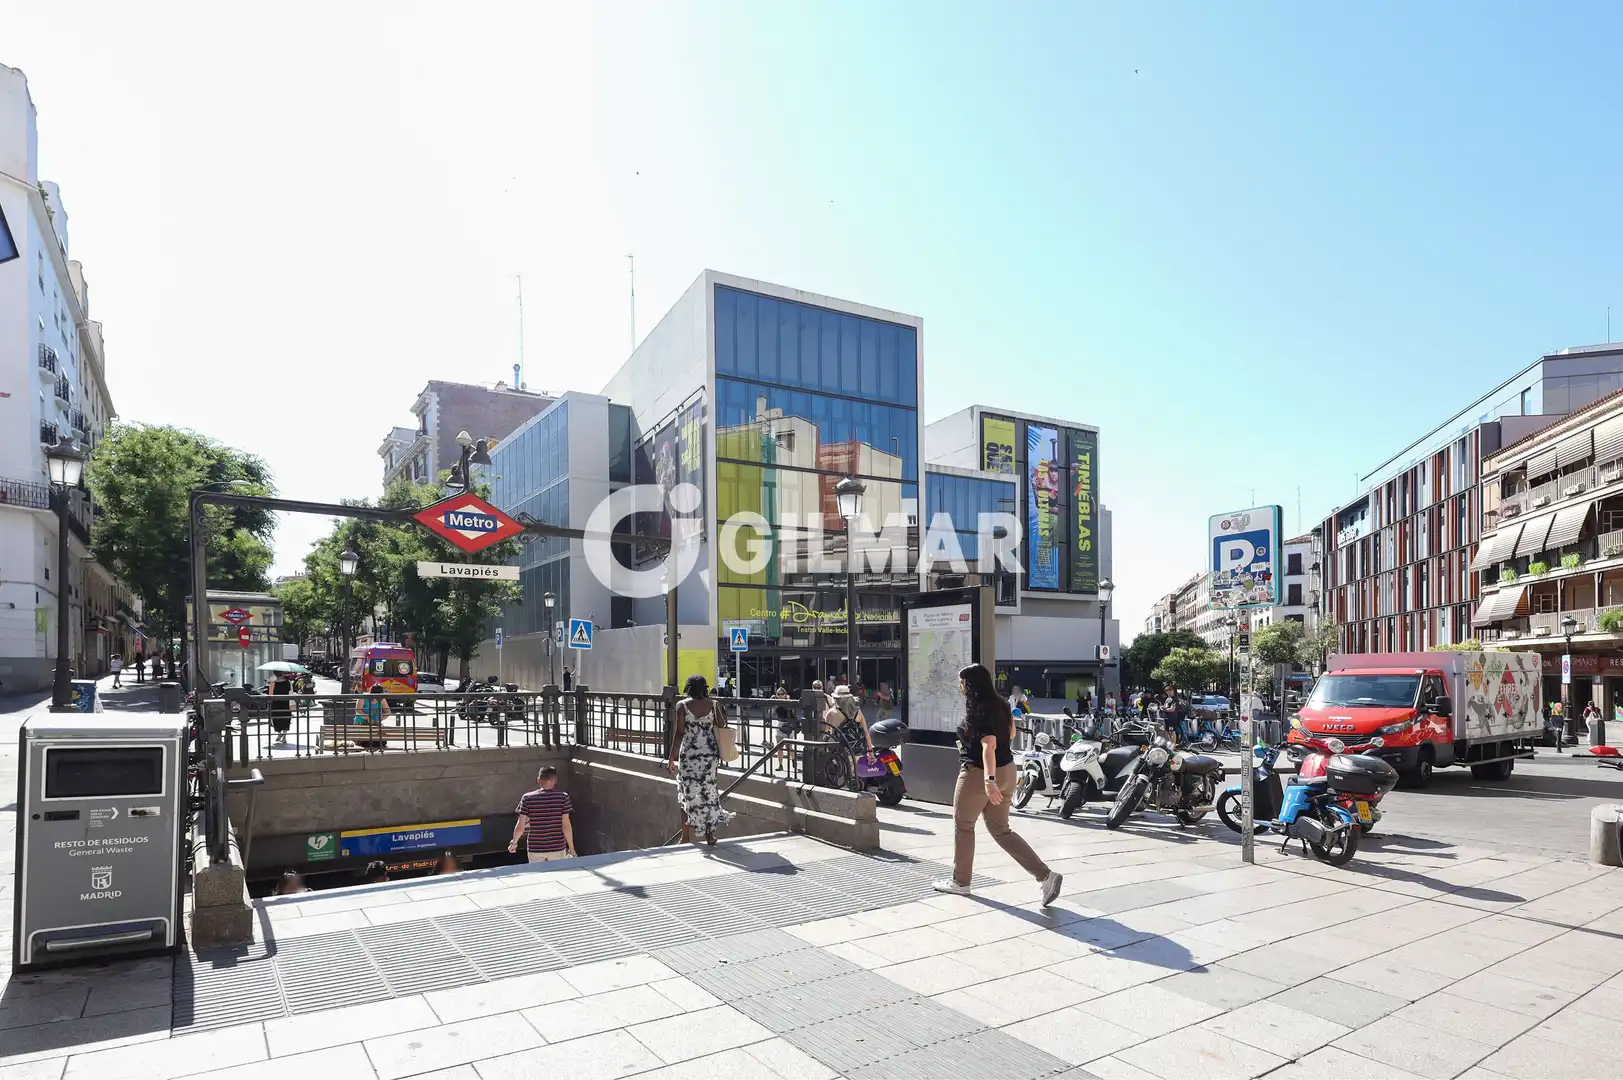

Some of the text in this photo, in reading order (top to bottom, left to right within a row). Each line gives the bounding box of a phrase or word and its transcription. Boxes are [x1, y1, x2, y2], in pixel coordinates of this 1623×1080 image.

[1078, 452, 1092, 551] TINIEBLAS
[449, 513, 494, 529] Metro
[1220, 539, 1255, 580] P
[440, 565, 499, 577] Lavapiés
[750, 608, 777, 618] Centro
[797, 625, 816, 634] Teatro
[1322, 724, 1355, 732] IVECO
[54, 836, 149, 849] RESTO DE RESIDUOS
[392, 831, 435, 843] Lavapiés
[68, 846, 134, 857] General Waste
[413, 860, 438, 868] Madrid
[80, 890, 122, 901] MADRID
